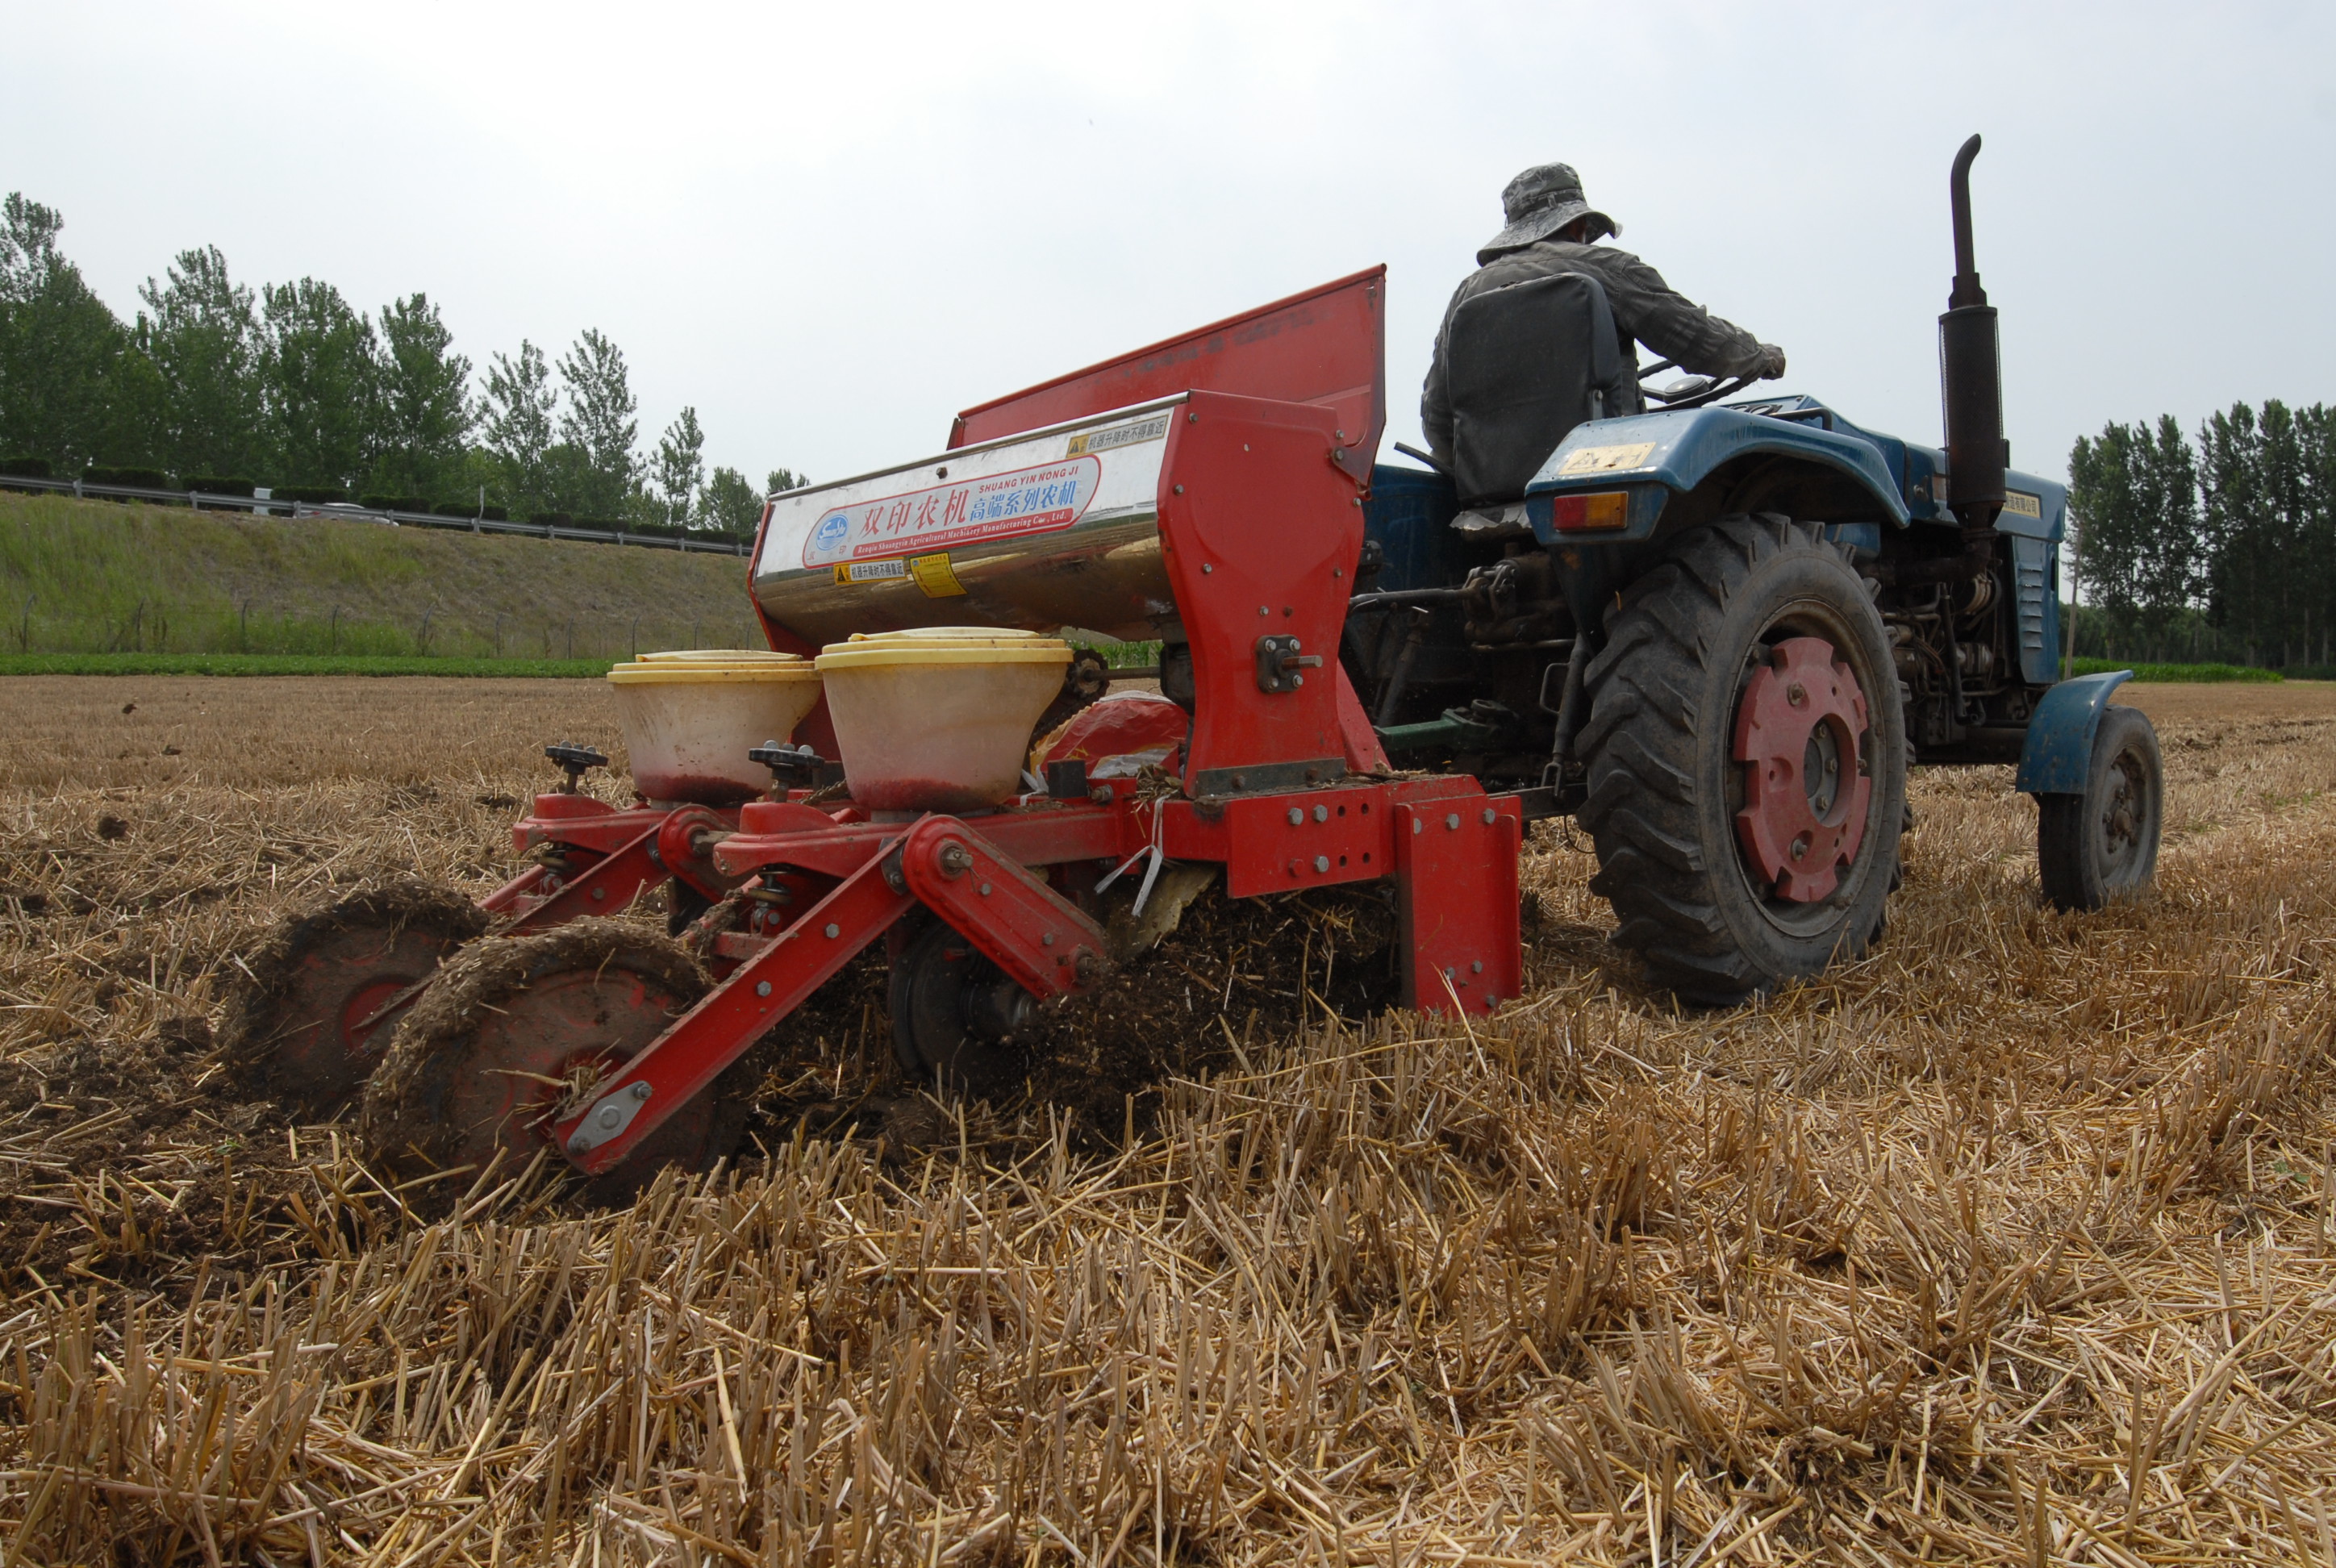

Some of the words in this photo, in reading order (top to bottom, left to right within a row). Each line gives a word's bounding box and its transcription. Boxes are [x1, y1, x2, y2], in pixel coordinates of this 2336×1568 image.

[1088, 420, 1165, 450] 机器升降时不得靠近
[978, 478, 1017, 494] SHUANG
[1020, 474, 1037, 486] YIN
[1038, 468, 1066, 482] NONG
[1069, 465, 1079, 476] JI
[857, 489, 970, 540] 双印农机
[970, 480, 1077, 522] 高端系列农机
[857, 544, 878, 554] Renqiu
[878, 540, 909, 551] Shuangyin
[909, 532, 946, 546] Agricultural
[948, 527, 981, 540] Machinery
[982, 519, 1032, 532] Manufacturing
[1052, 511, 1066, 521] Ltd.
[851, 563, 903, 579] 机器升降时不得靠近
